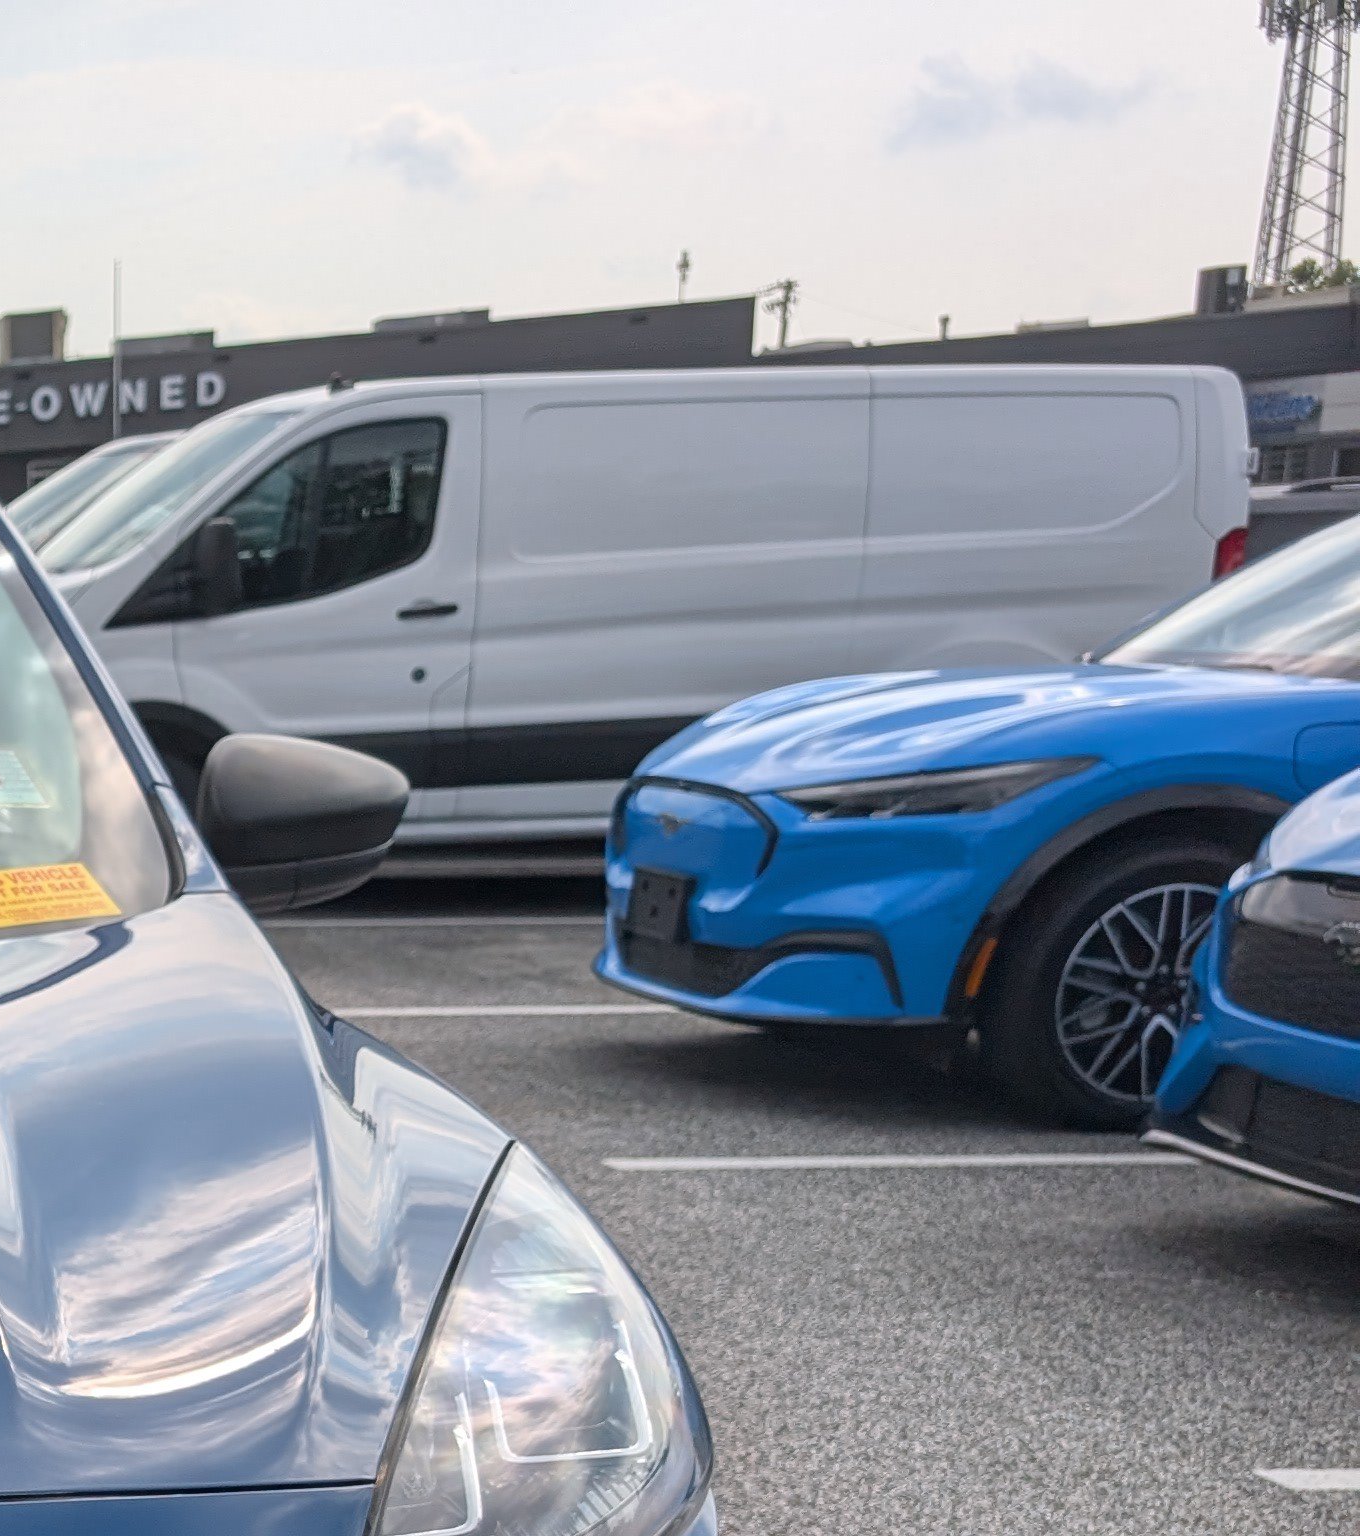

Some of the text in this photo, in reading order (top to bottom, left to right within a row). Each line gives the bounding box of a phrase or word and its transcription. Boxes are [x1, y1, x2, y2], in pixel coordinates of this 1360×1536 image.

[5, 866, 85, 884] VEHICLE
[11, 885, 45, 897] FOR
[48, 880, 90, 893] SALE
